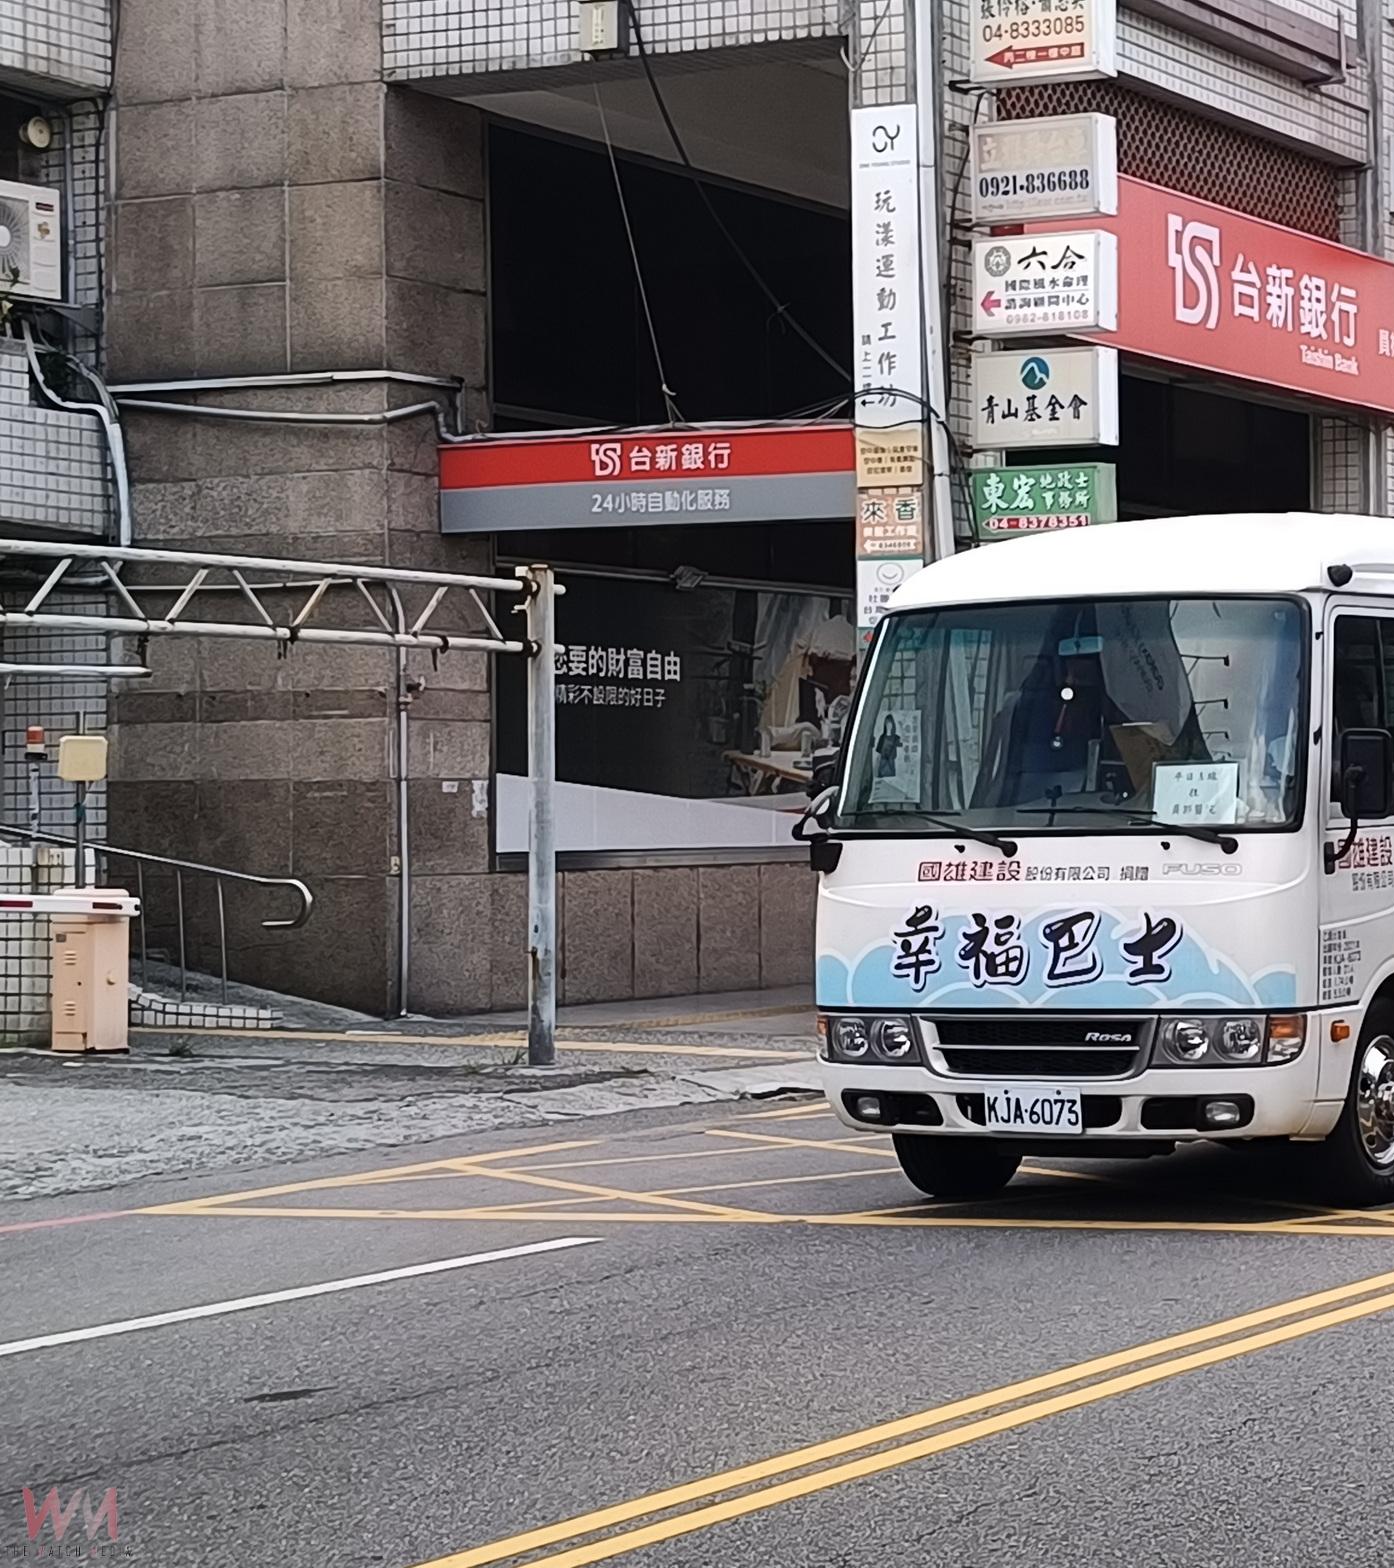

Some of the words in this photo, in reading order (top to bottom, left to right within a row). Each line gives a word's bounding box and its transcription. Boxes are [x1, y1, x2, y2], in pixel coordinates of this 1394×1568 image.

[1017, 245, 1087, 271] 六合
[1231, 253, 1358, 347] 台新銀行
[981, 394, 1088, 424] 青山基金會
[629, 443, 732, 471] 台新銀行
[591, 489, 731, 514] 24小時自動化服務
[1162, 863, 1243, 876] FUSO
[892, 904, 1184, 992] 幸福巴士
[987, 1096, 1080, 1126] KJA-6073
